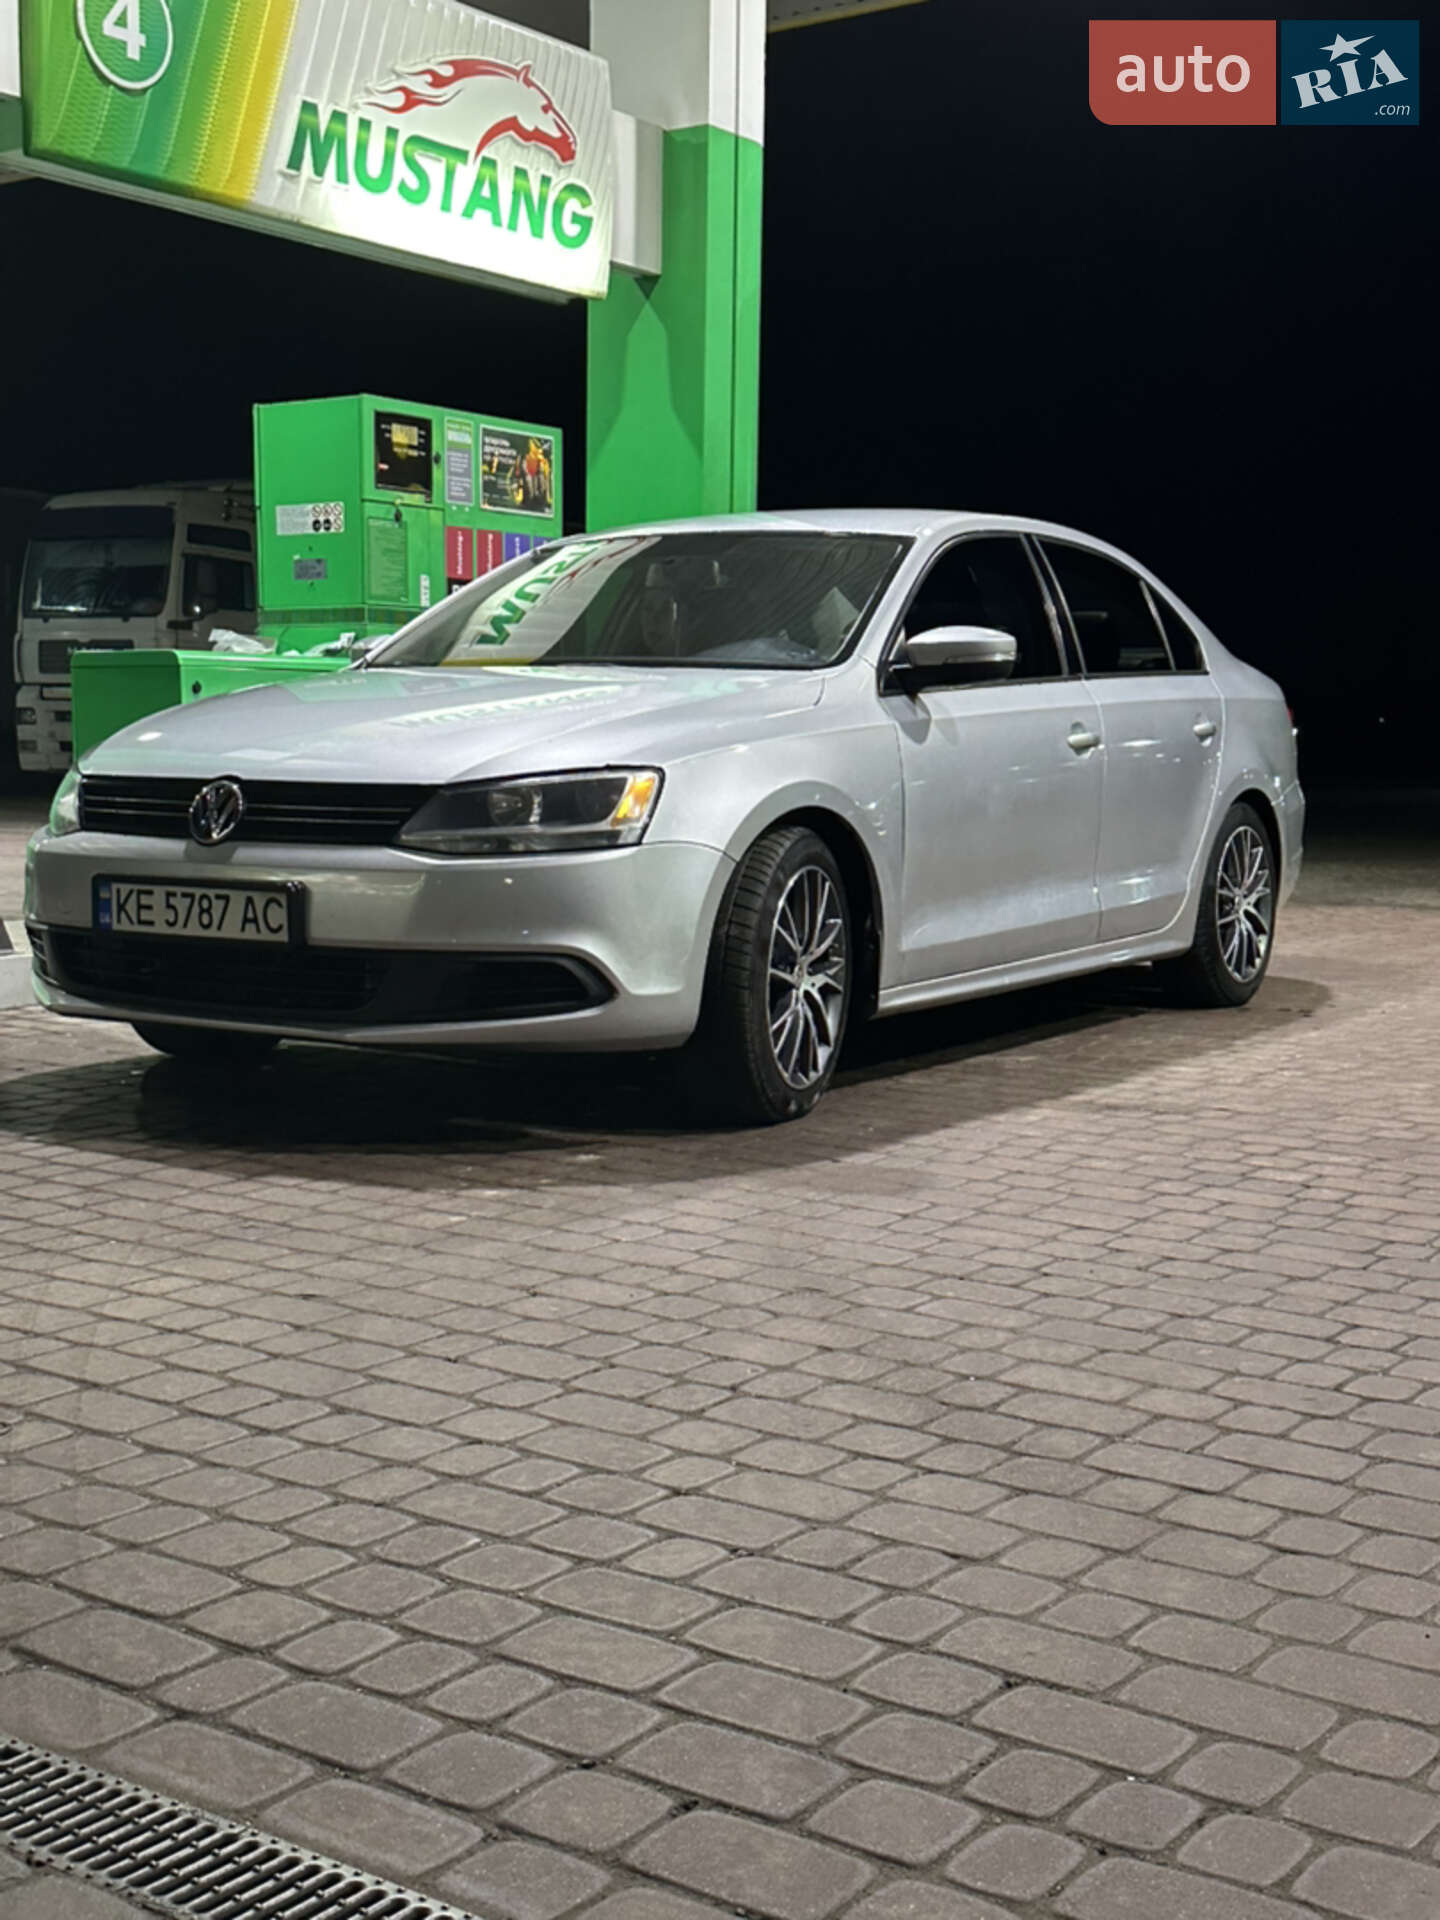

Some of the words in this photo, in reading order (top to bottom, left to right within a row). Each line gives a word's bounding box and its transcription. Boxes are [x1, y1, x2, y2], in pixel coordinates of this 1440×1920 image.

[100, 0, 147, 61] 4
[285, 99, 595, 250] MUSTANG
[115, 887, 156, 926] KE
[164, 889, 231, 932] 5787
[240, 895, 285, 935] AC
